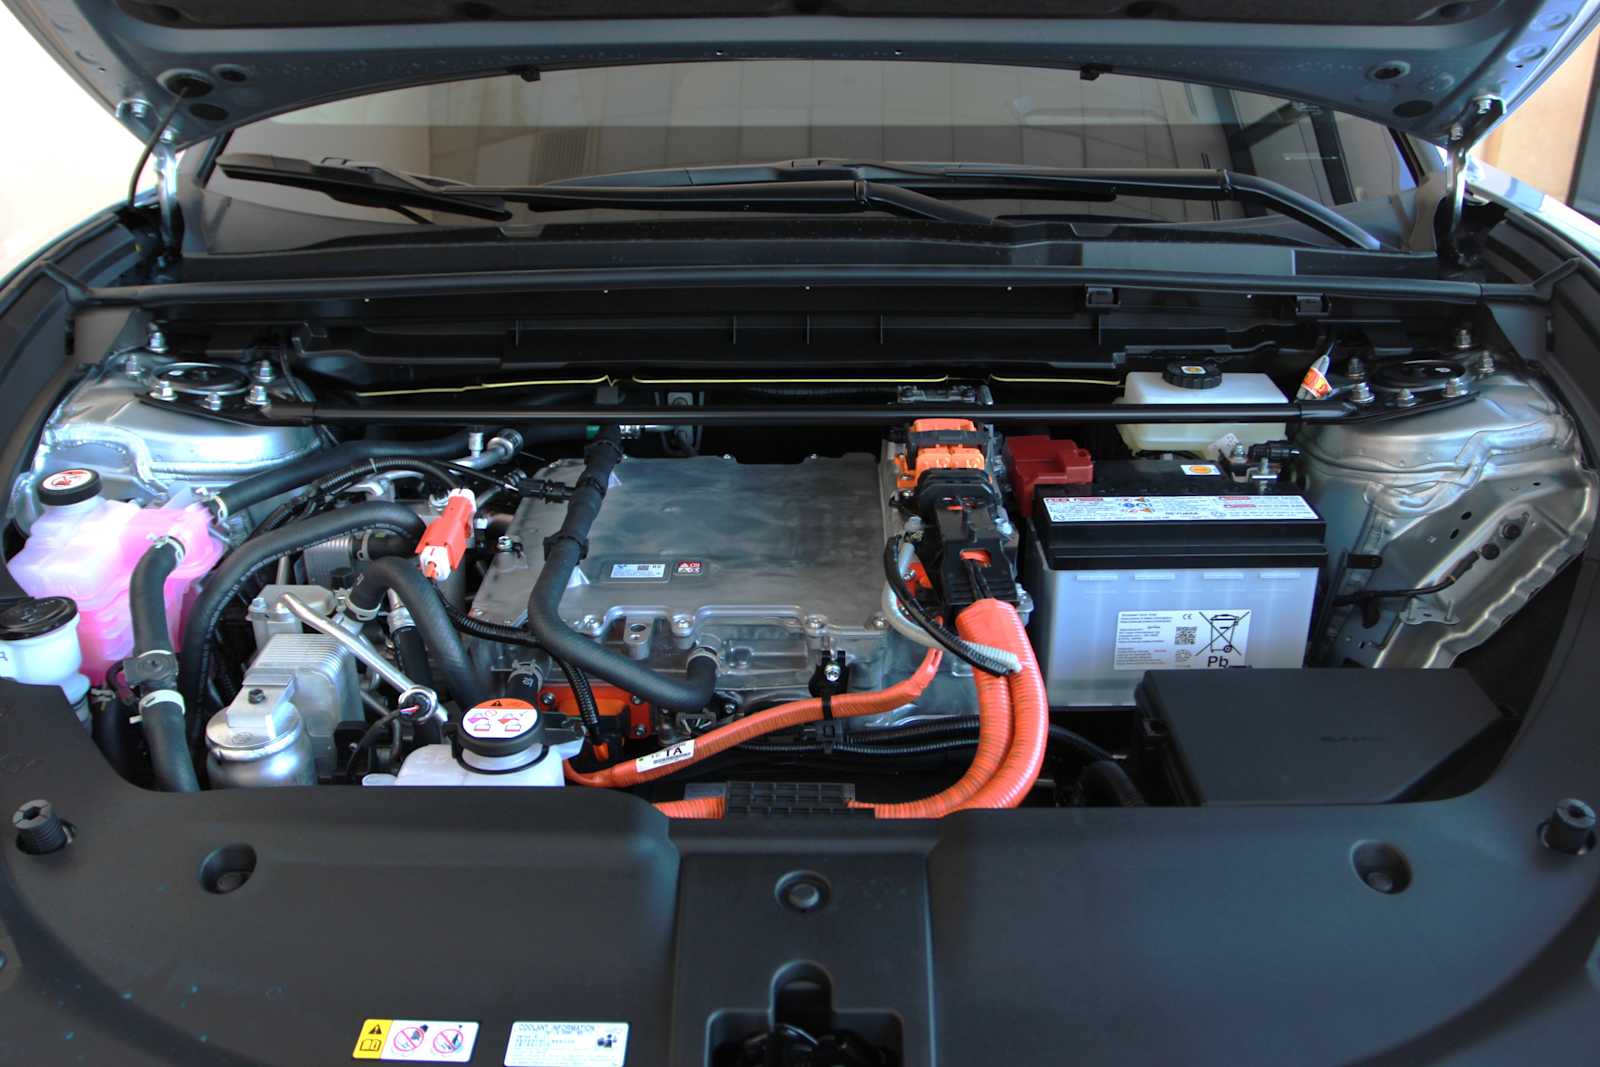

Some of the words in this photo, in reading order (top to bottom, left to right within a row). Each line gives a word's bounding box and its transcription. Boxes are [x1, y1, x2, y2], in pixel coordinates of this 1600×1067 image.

[1207, 656, 1230, 668] Pb
[519, 1024, 546, 1032] COOLANT
[551, 1025, 595, 1033] INFORMATION
